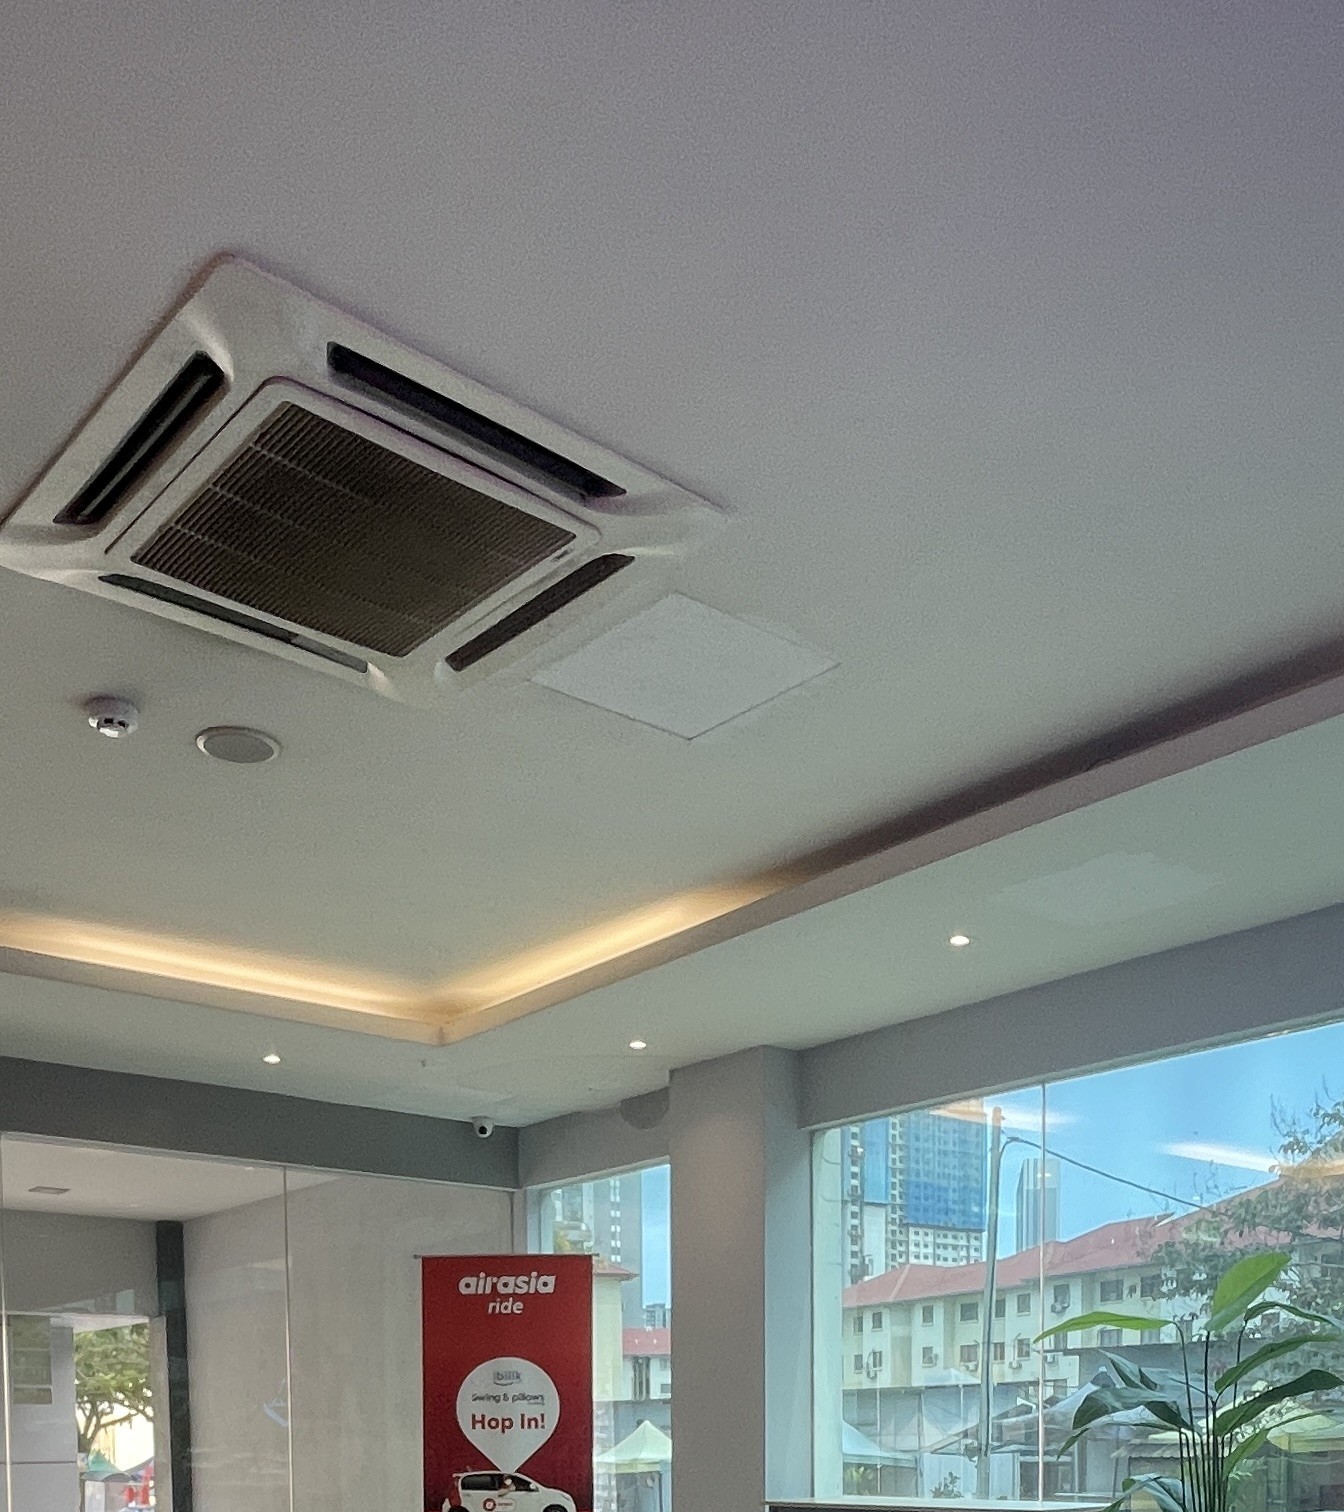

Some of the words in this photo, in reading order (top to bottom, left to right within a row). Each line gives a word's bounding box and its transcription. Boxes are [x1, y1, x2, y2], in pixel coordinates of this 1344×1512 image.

[458, 1271, 556, 1295] airasia
[488, 1297, 524, 1314] ride
[471, 1413, 514, 1434] Hop
[520, 1413, 545, 1430] In!
